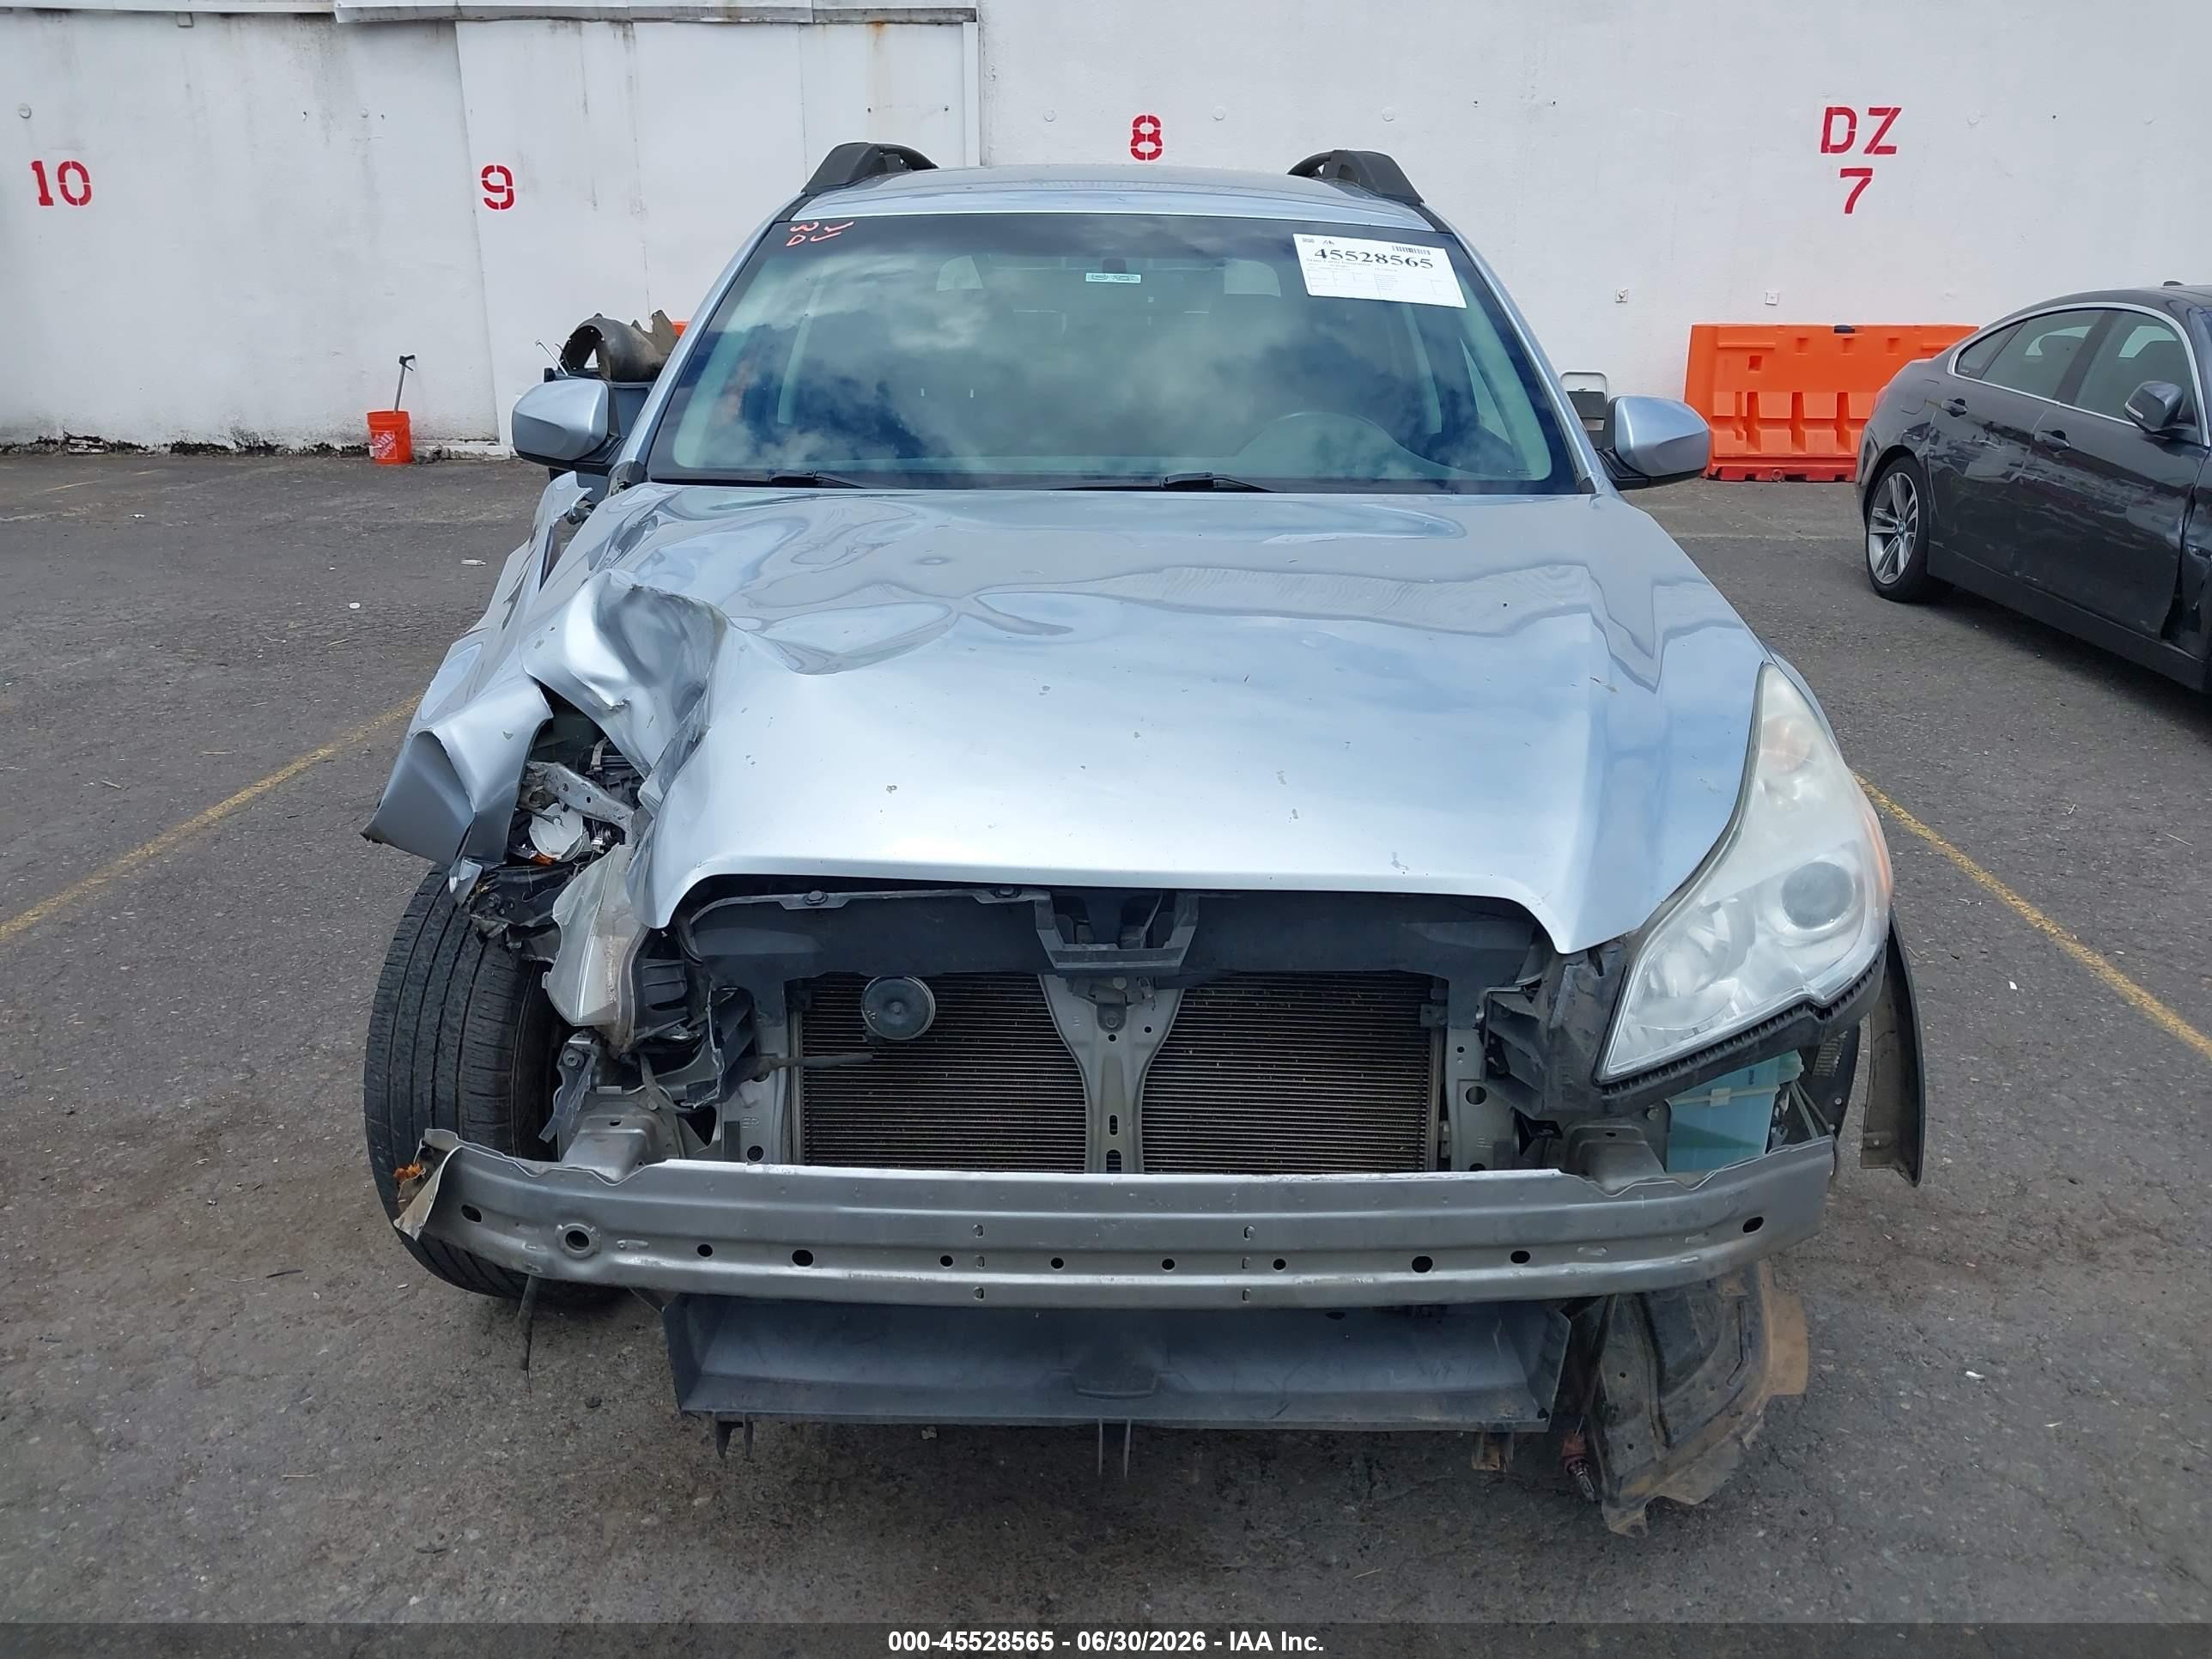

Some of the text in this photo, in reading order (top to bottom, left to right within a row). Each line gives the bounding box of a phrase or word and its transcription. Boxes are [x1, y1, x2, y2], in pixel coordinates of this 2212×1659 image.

[1130, 115, 1164, 161] 8
[1820, 106, 1901, 155] DZ
[31, 160, 93, 207] 10
[481, 164, 516, 211] 9
[1840, 167, 1874, 215] 7
[1315, 248, 1434, 270] 45528565
